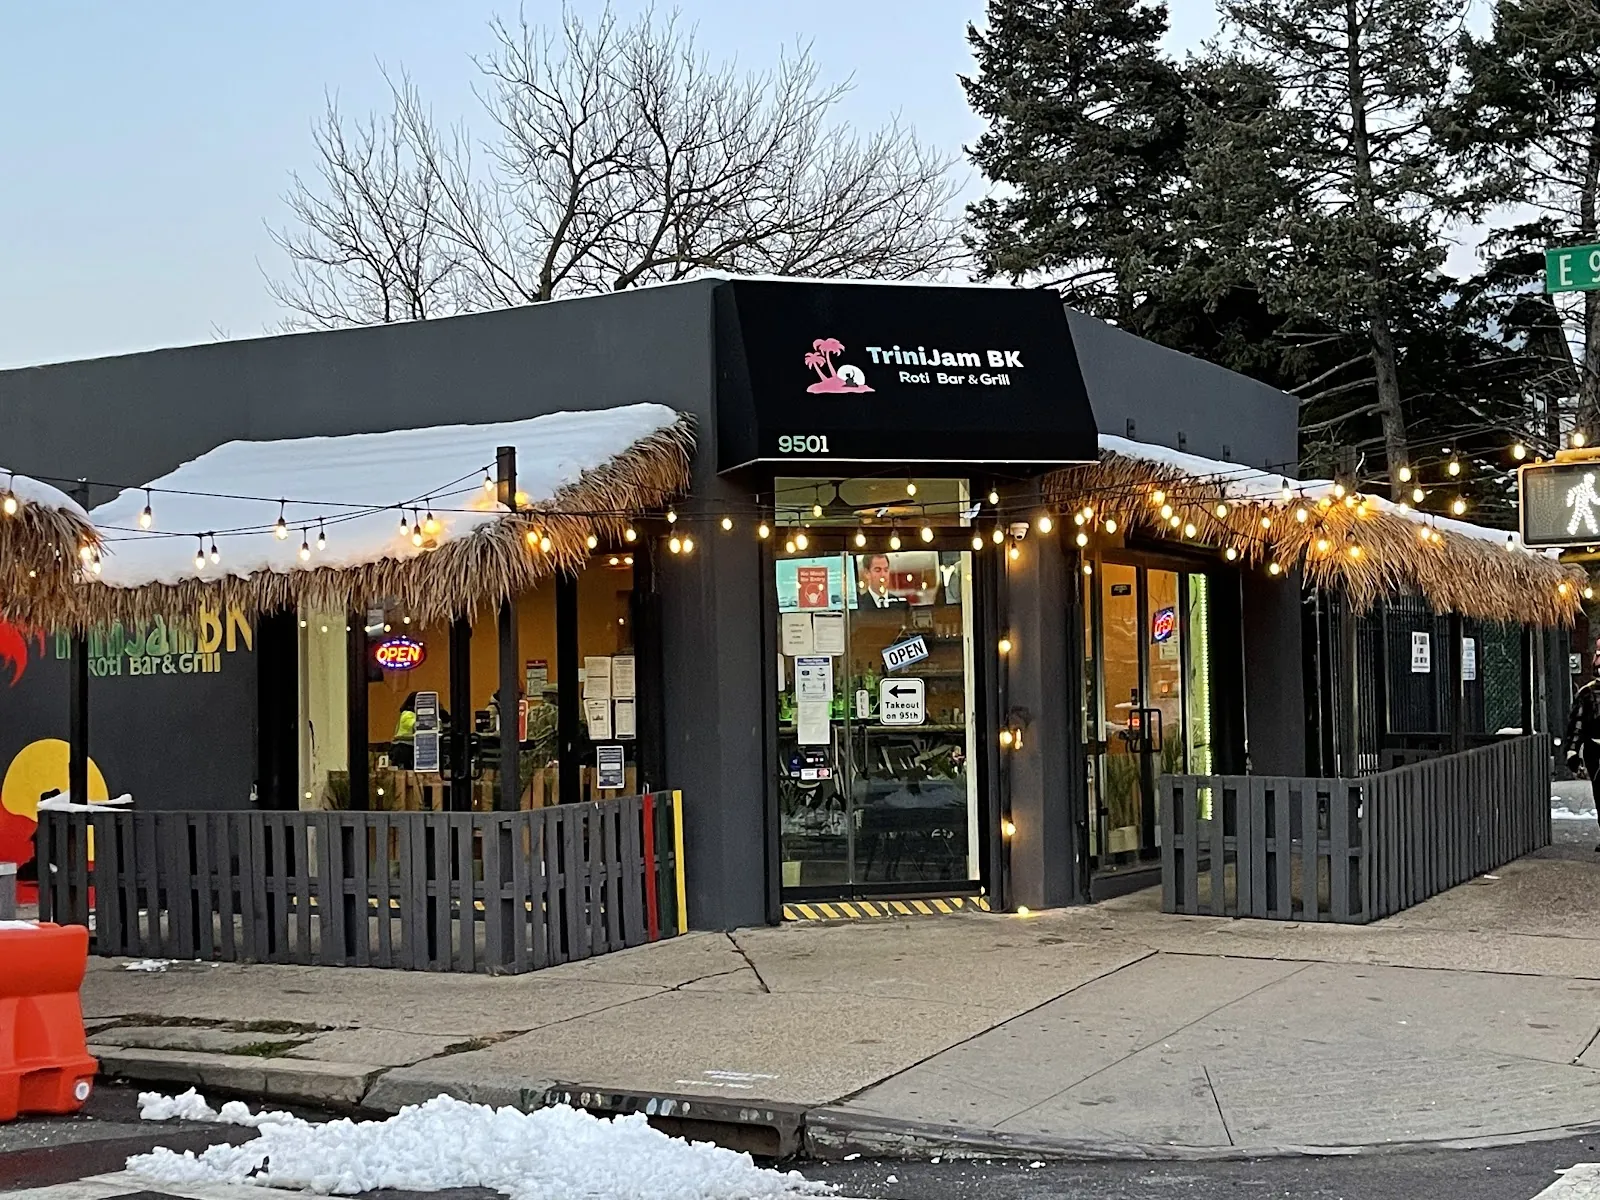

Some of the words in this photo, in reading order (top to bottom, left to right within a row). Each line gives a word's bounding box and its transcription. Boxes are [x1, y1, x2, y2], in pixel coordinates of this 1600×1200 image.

[1559, 254, 1574, 286] E
[865, 344, 982, 368] TriniJam
[986, 349, 1025, 368] BK
[899, 370, 931, 384] Roti
[936, 372, 966, 385] Bar
[979, 373, 1011, 386] Grill
[778, 435, 830, 453] 9501
[376, 647, 420, 662] OPEN
[889, 641, 924, 666] OPEN
[88, 656, 122, 677] Roti
[885, 701, 920, 709] Takeout
[899, 711, 919, 719] 95th
